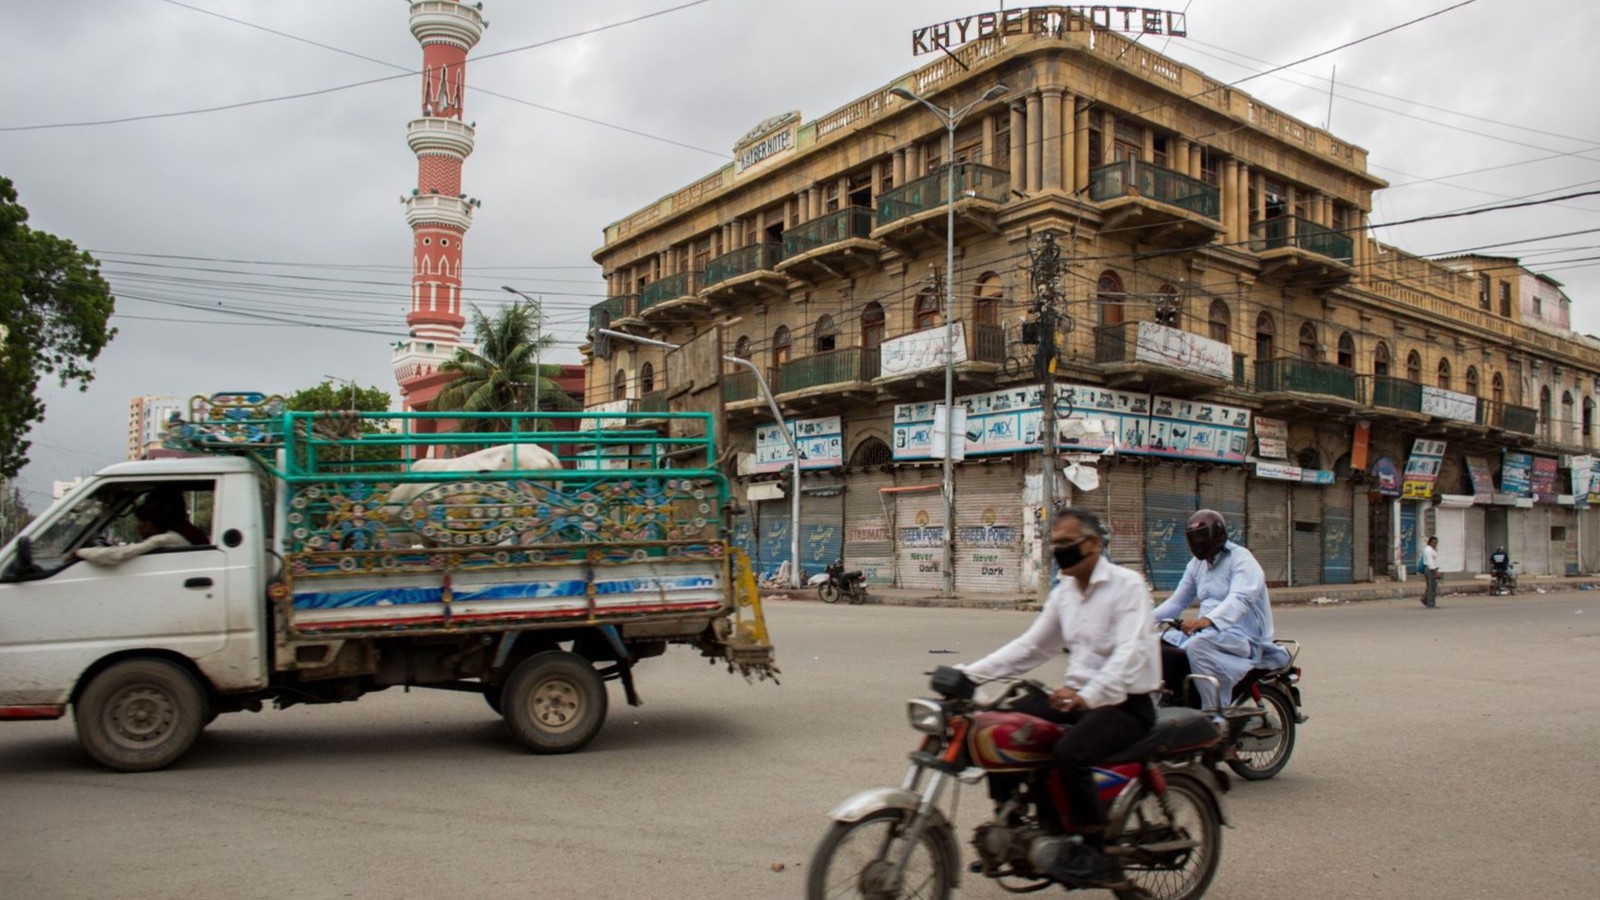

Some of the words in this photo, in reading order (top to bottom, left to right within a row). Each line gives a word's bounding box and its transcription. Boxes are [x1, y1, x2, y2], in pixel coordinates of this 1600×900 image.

[913, 7, 1050, 56] KHYBER
[1067, 6, 1187, 38] HOTEL
[923, 527, 943, 542] POWE
[987, 527, 1015, 542] POWER
[911, 552, 933, 561] Never
[973, 554, 998, 562] Never
[919, 564, 939, 573] Dark
[981, 566, 1004, 576] Dark
